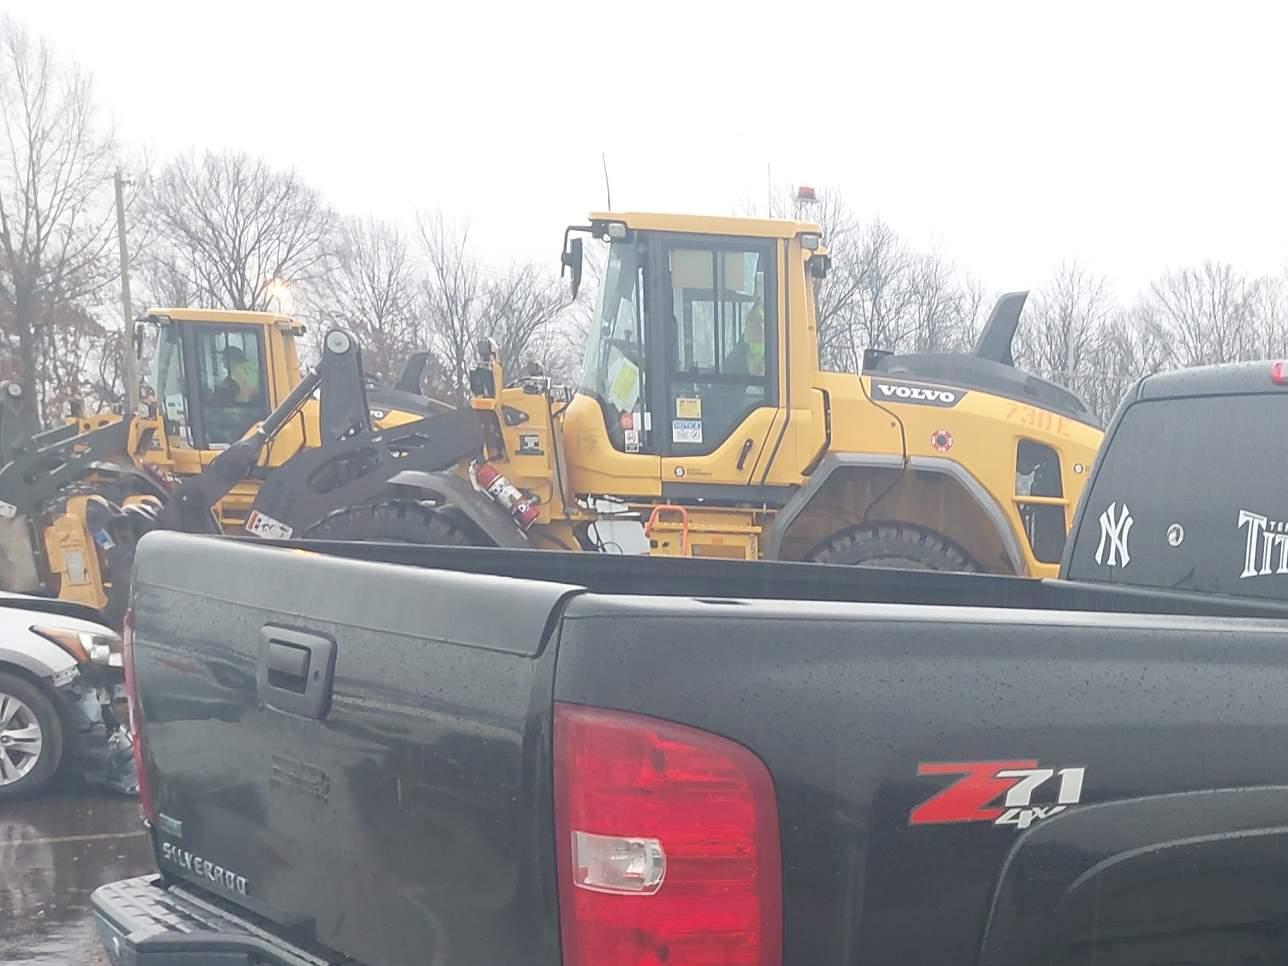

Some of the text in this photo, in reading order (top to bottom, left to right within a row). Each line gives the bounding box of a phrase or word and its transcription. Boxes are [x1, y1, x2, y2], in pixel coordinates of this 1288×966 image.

[878, 384, 955, 403] VOLVO
[909, 759, 1085, 825] Z71
[162, 841, 248, 895] SILVERADO
